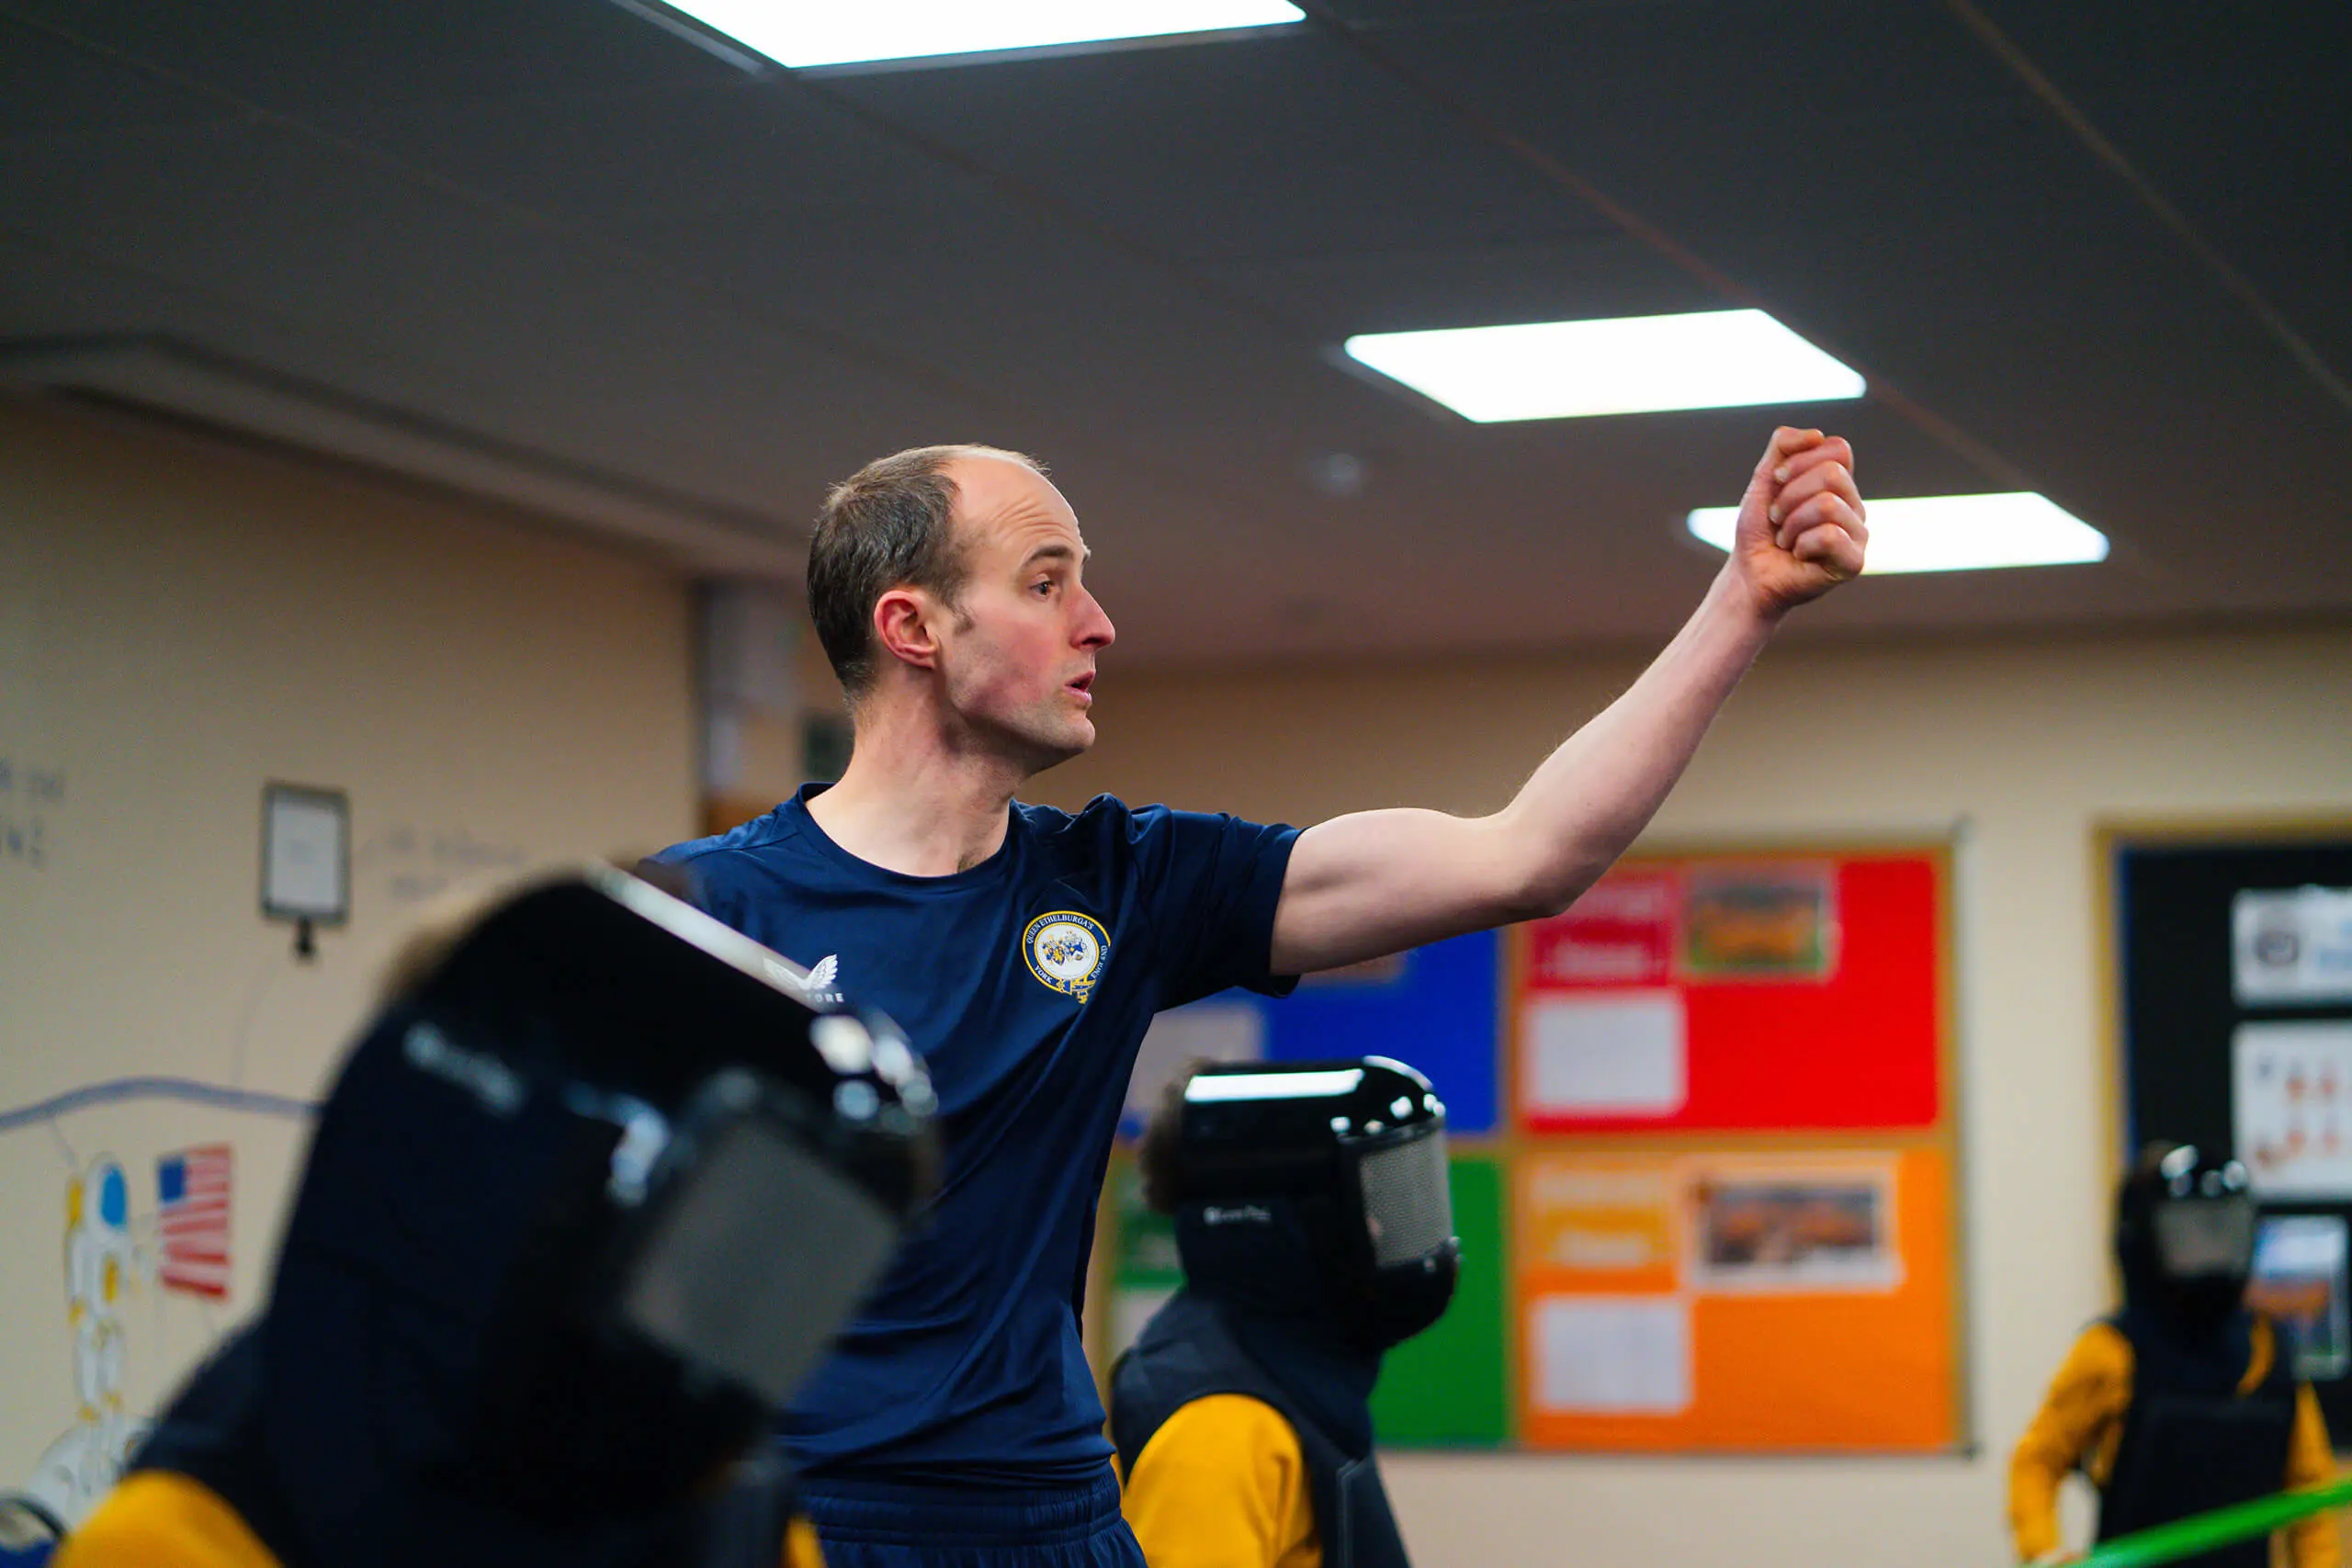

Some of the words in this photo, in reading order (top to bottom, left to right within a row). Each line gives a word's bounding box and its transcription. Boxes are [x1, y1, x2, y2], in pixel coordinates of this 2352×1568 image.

[1026, 922, 1041, 944] QUEEN
[1040, 914, 1094, 930] ETHELBURGA'S
[1035, 964, 1053, 984] YORK
